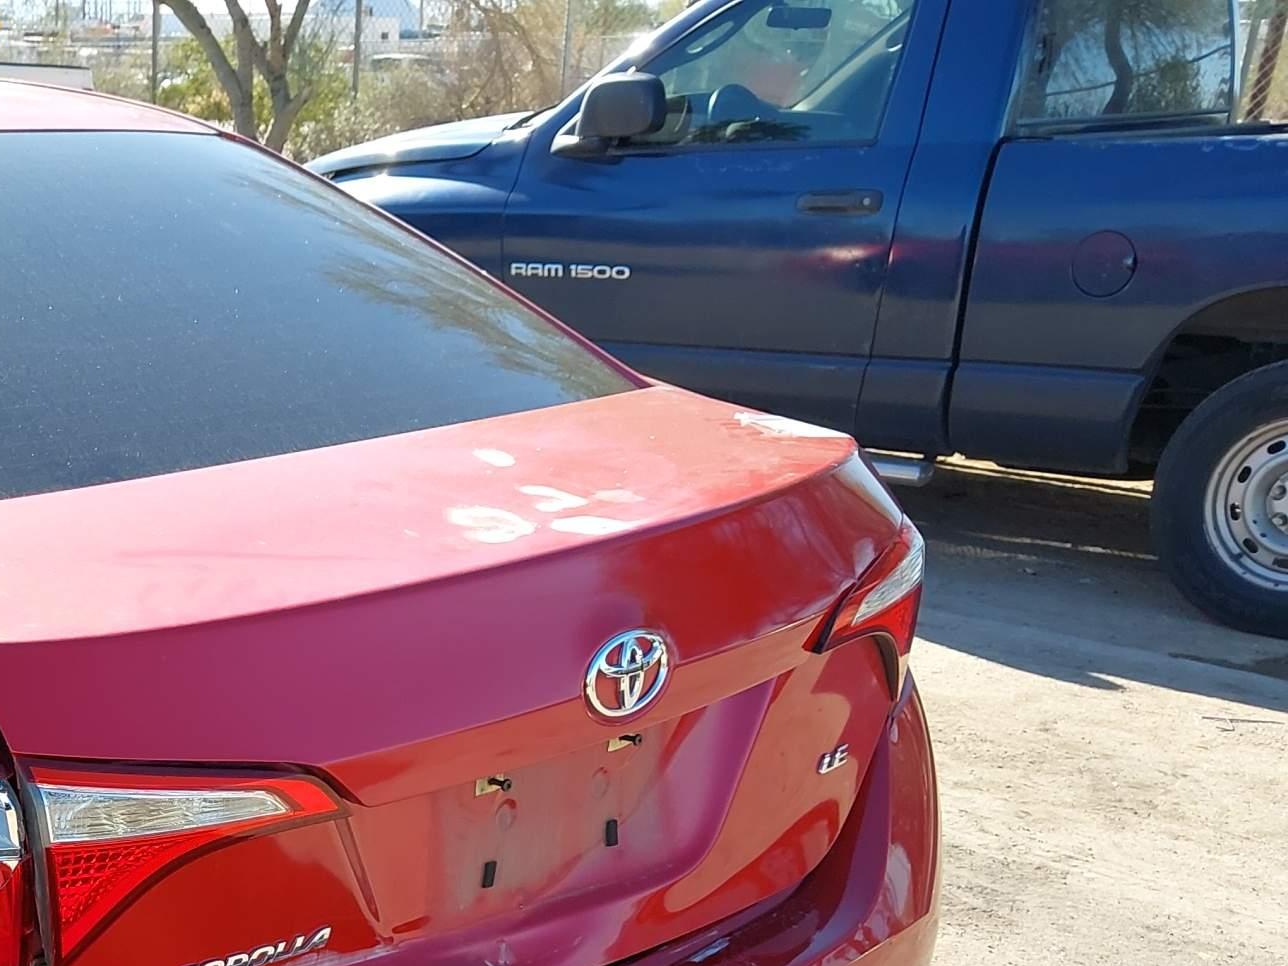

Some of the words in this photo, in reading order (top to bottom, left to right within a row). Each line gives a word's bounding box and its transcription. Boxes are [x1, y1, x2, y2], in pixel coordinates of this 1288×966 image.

[510, 262, 564, 278] RAM
[569, 264, 631, 280] 1500
[816, 743, 849, 775] LE
